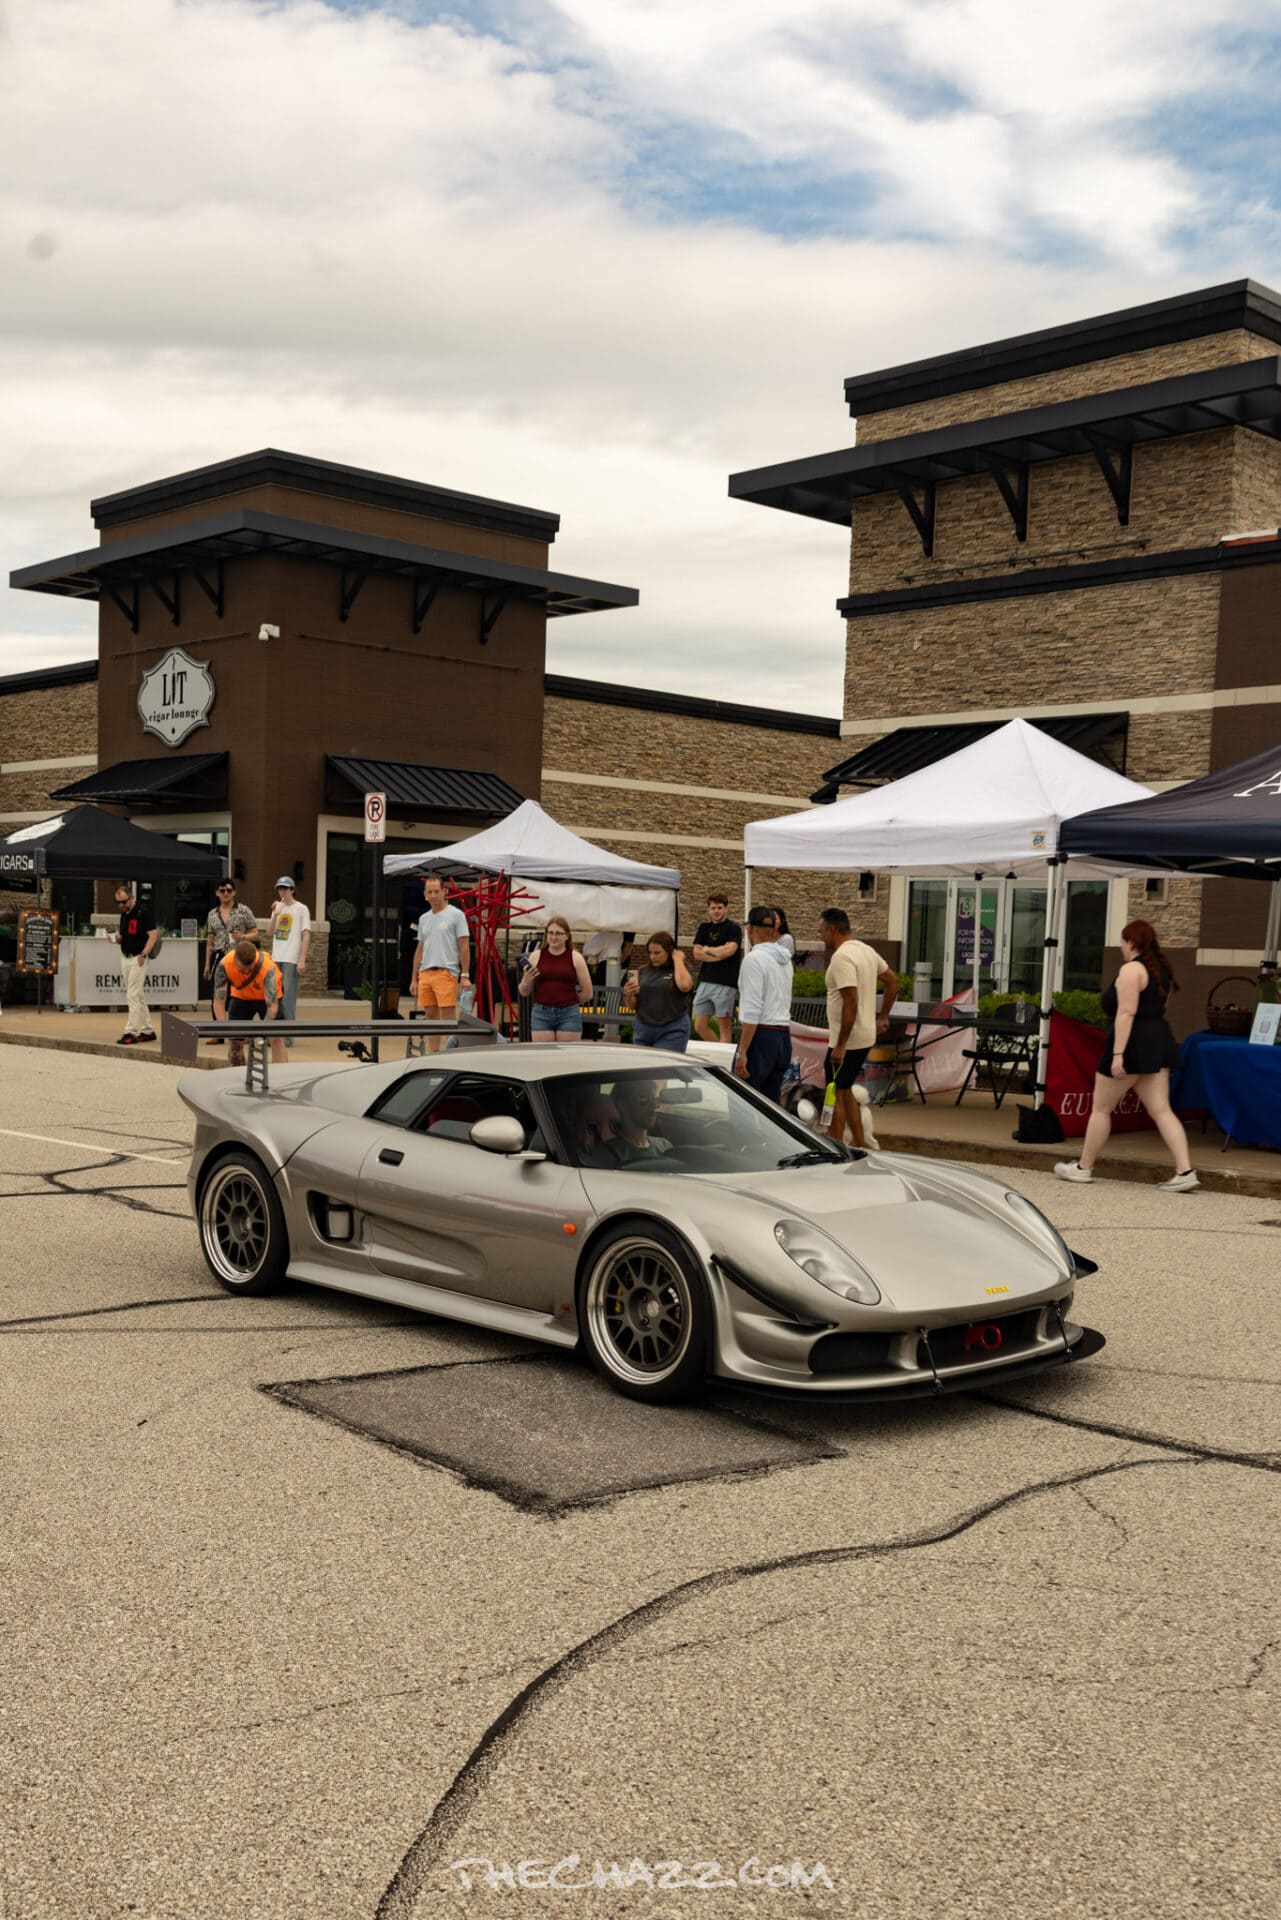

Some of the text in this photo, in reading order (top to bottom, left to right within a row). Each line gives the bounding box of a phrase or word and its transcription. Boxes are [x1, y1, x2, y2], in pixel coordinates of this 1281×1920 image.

[162, 671, 187, 706] LIT
[149, 708, 200, 723] cigar lounge
